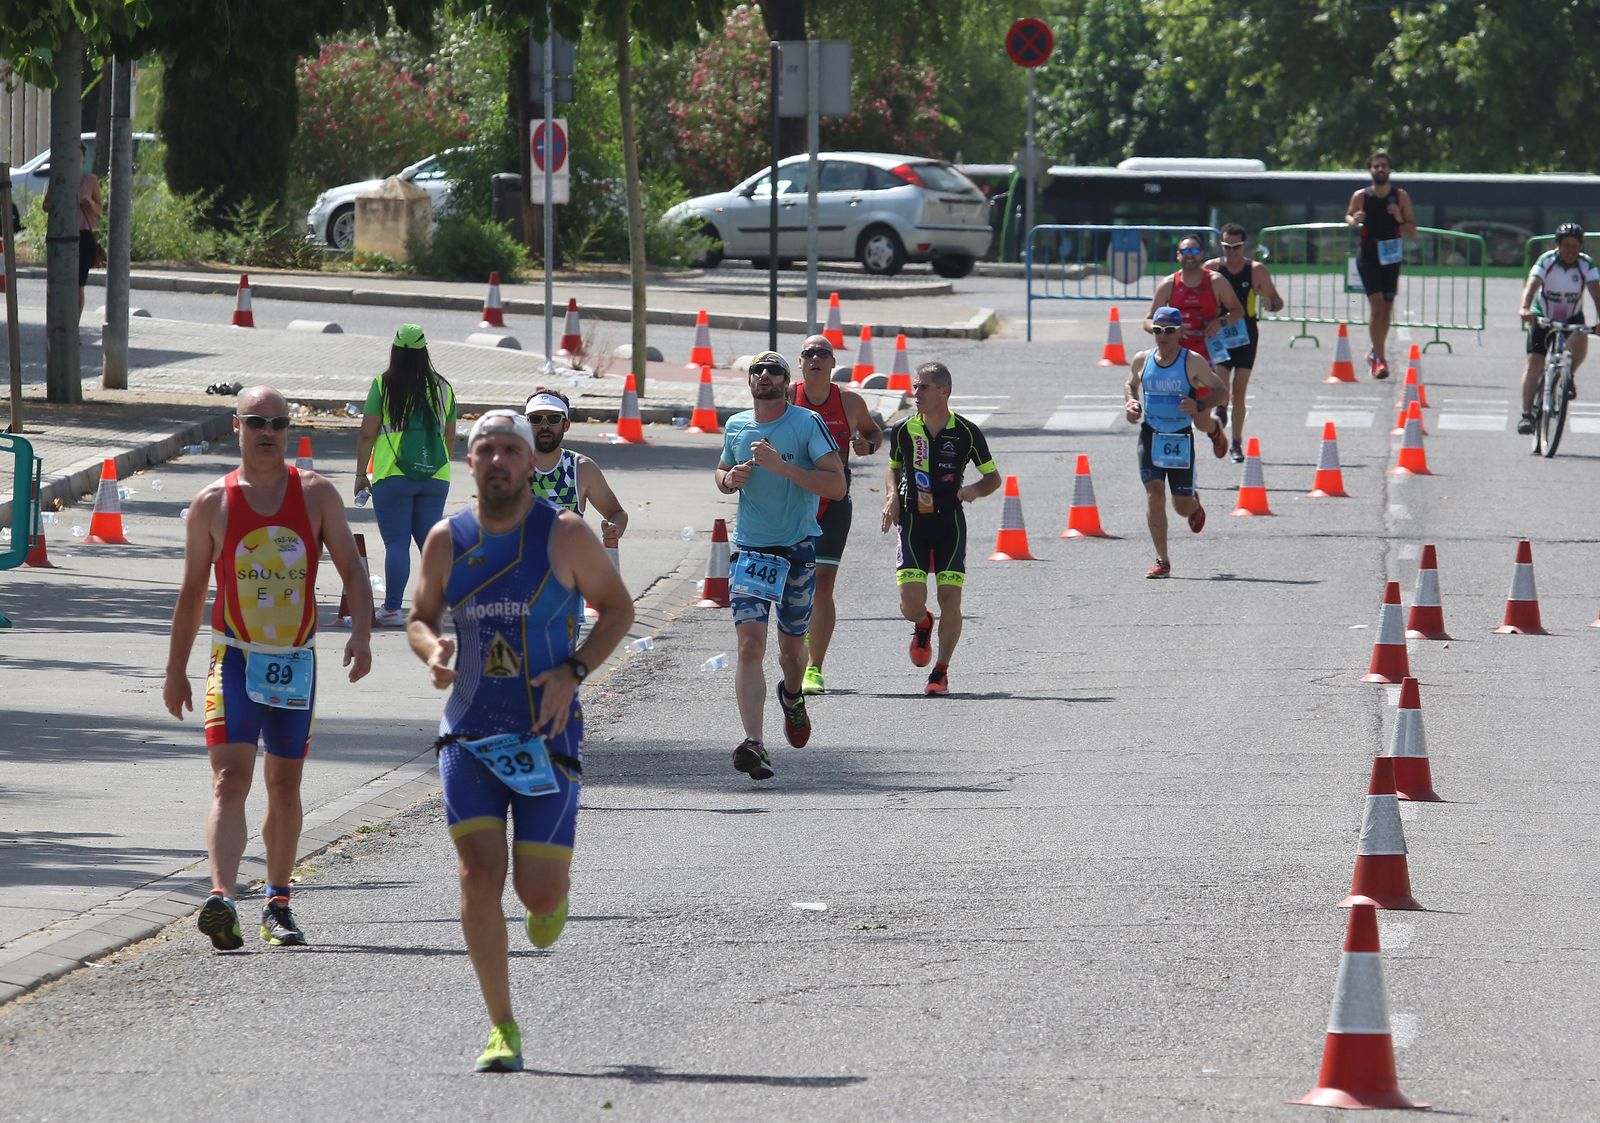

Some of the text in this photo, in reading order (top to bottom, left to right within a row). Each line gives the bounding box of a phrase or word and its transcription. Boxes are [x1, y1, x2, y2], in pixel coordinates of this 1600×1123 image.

[1163, 442, 1181, 456] 64
[744, 562, 778, 585] 448
[265, 662, 293, 685] 89
